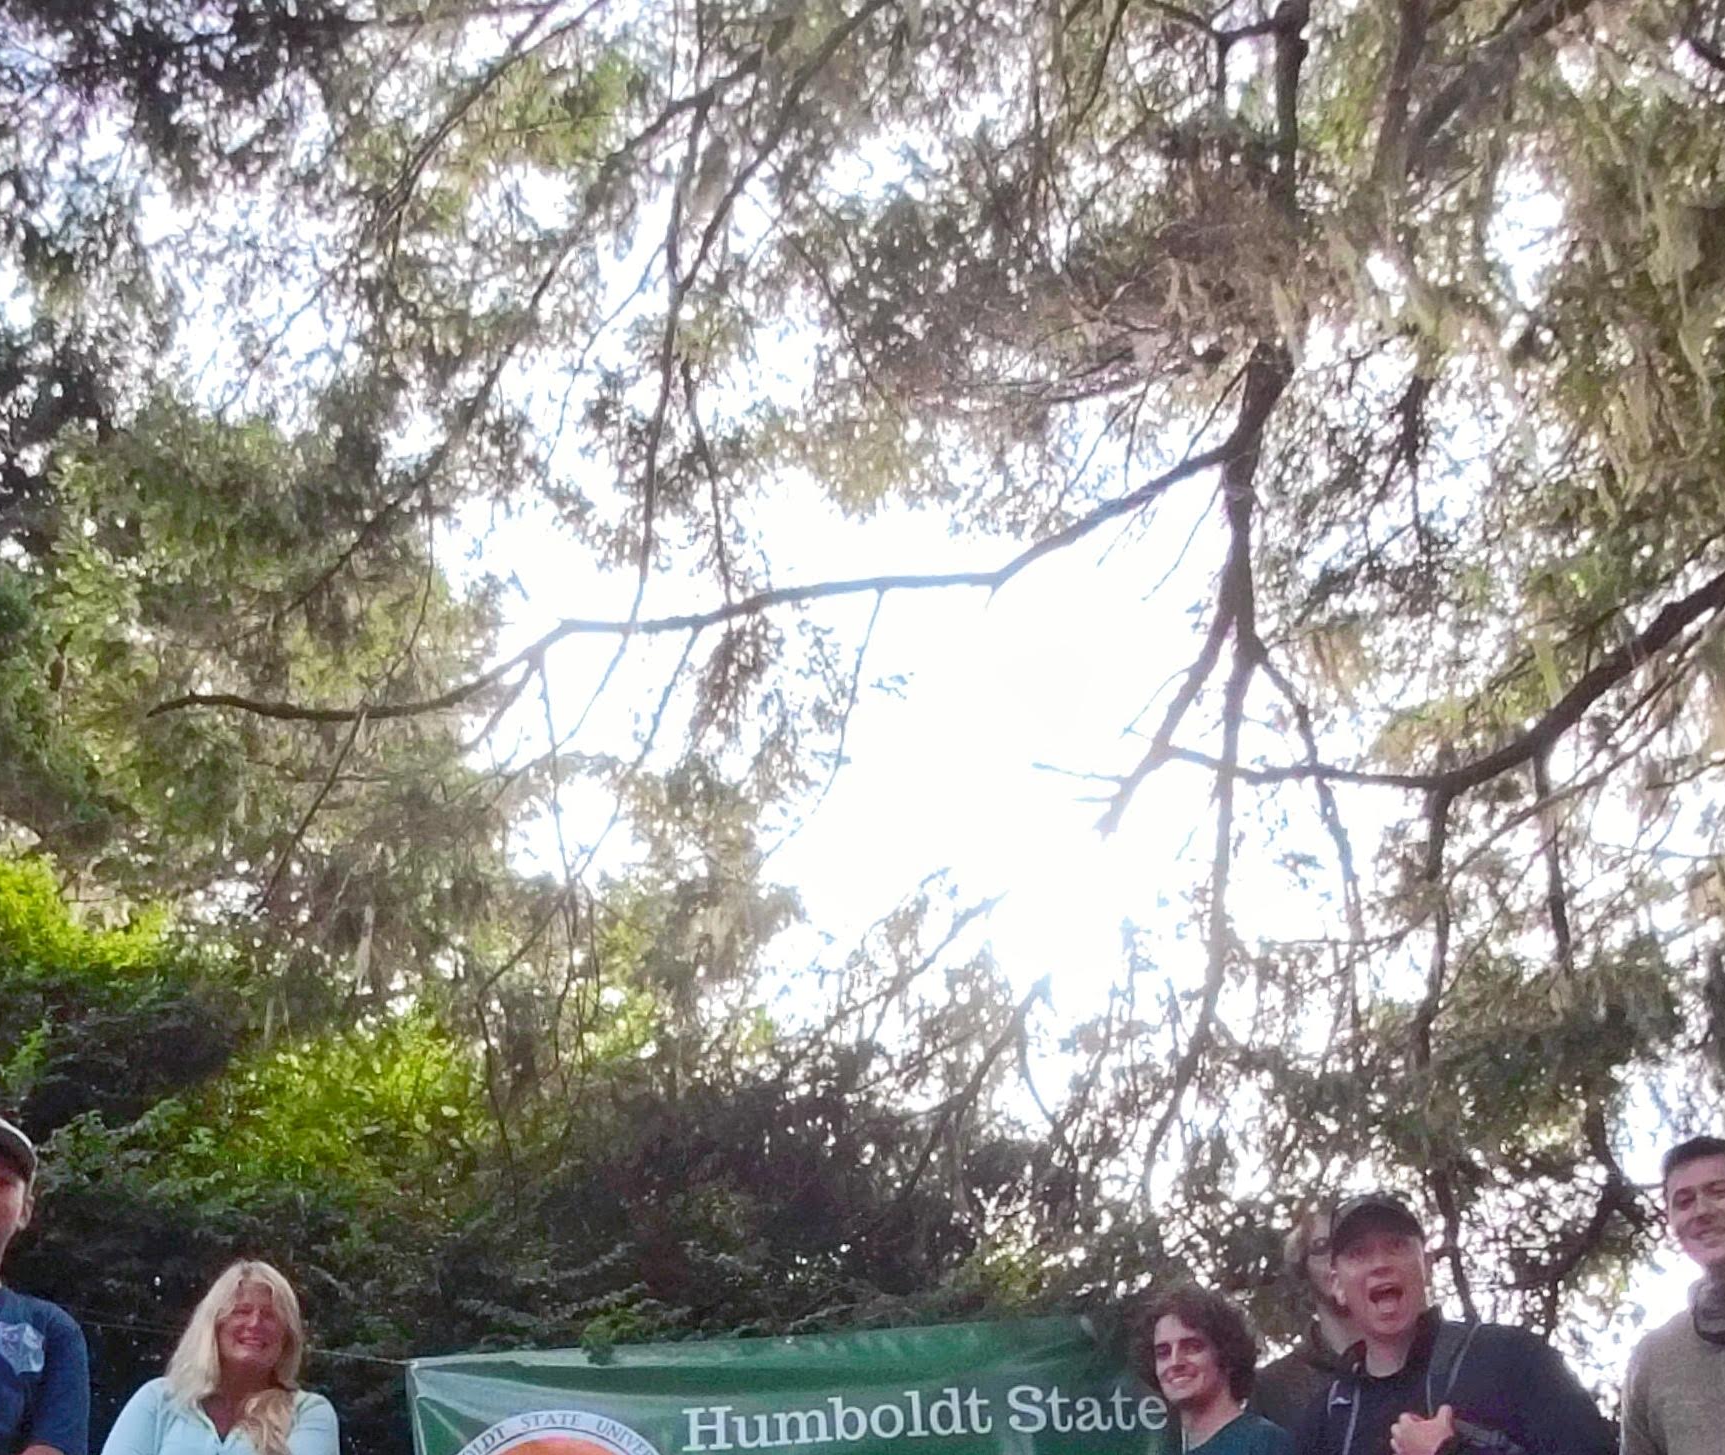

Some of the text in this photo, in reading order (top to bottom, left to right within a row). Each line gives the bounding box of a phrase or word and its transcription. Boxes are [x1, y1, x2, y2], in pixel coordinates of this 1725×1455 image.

[520, 1412, 582, 1429] STATE
[681, 1384, 1168, 1452] Humboldt State
